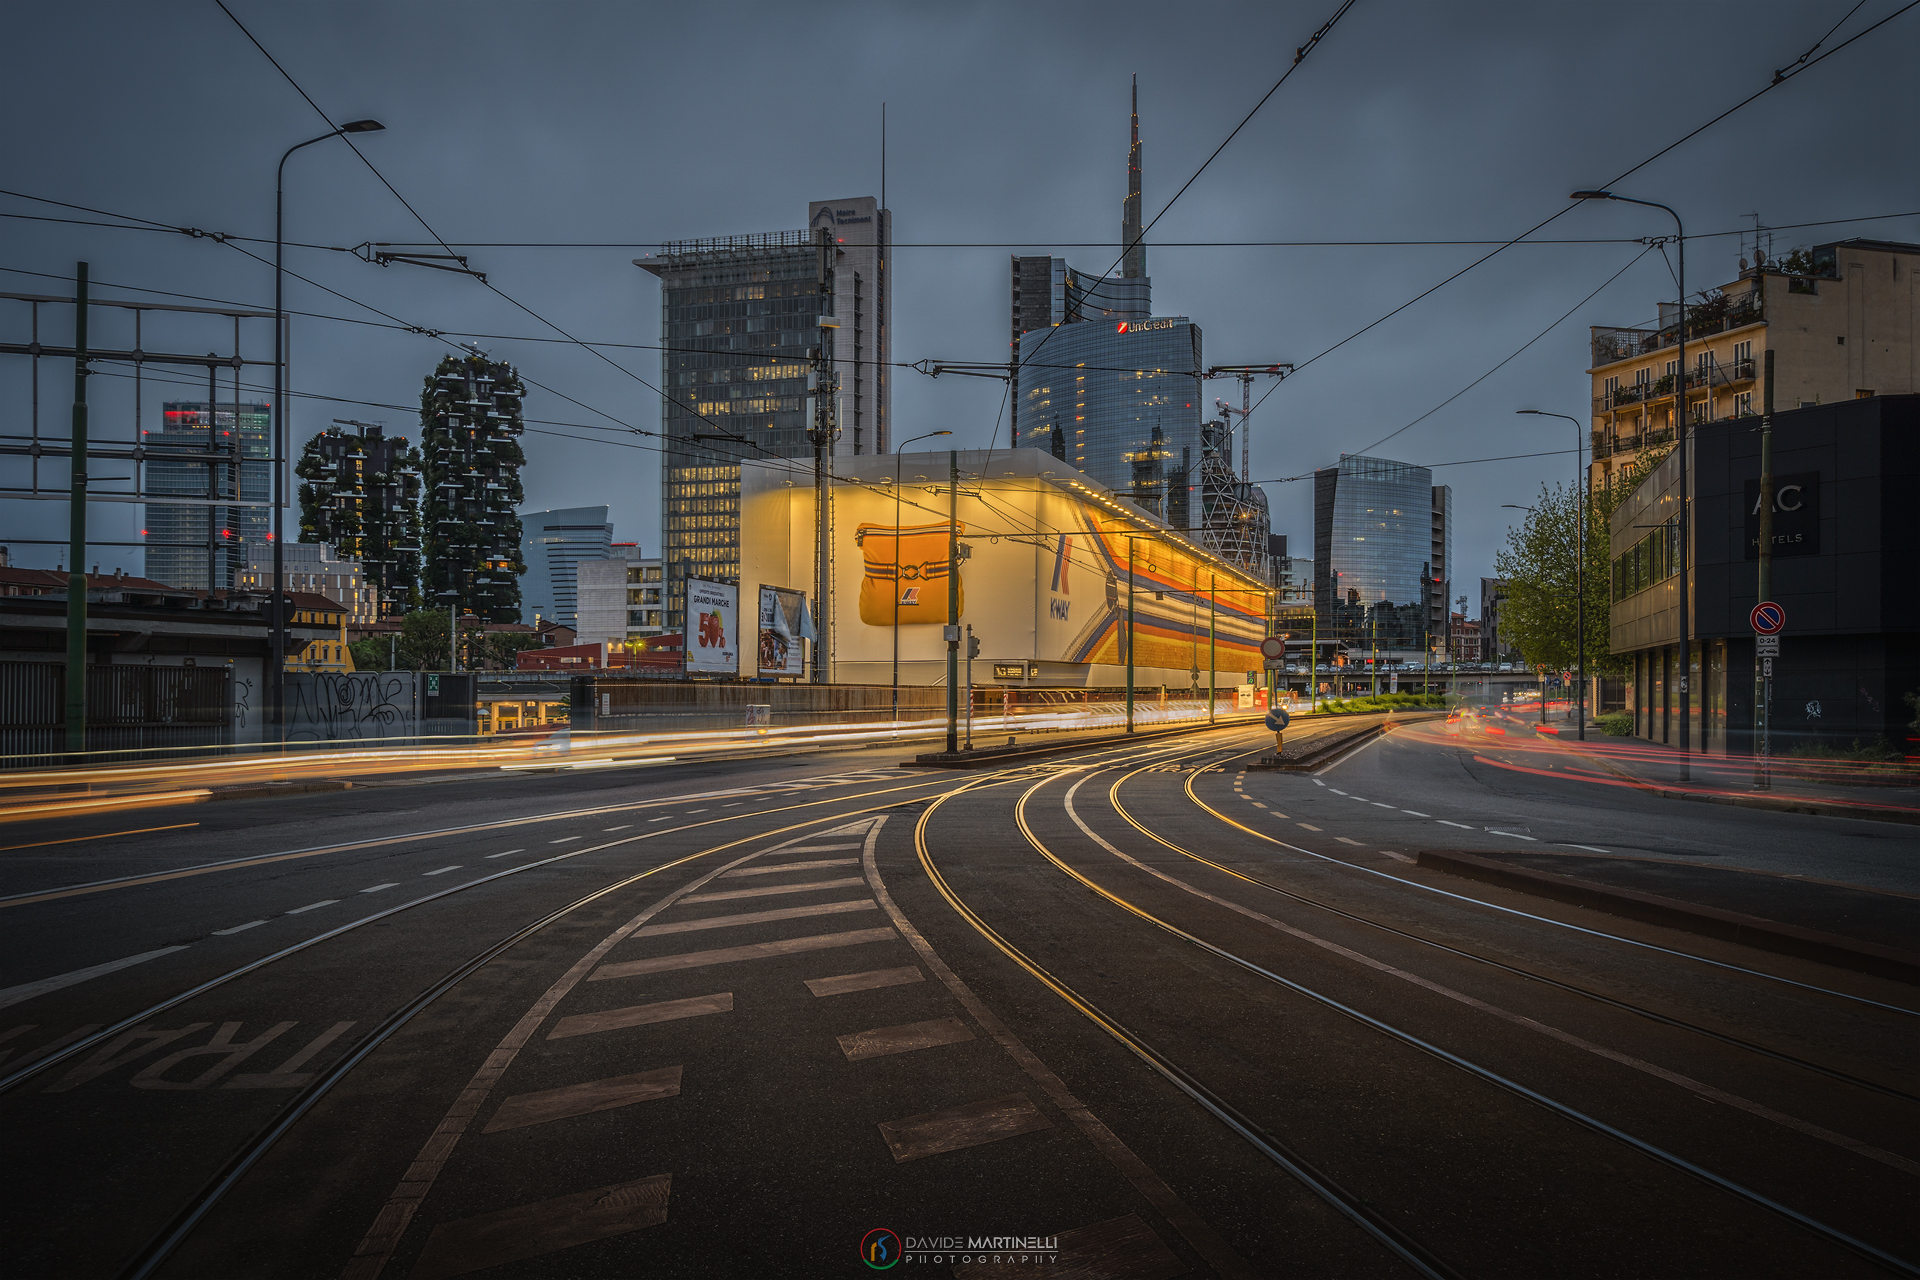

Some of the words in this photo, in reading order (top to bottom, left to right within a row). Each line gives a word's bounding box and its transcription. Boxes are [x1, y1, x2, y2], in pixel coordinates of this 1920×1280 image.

[837, 216, 871, 224] Tecnimont
[1129, 319, 1173, 332] UniCredit
[1752, 533, 1803, 546] HTELS
[693, 595, 711, 605] GRANDI
[711, 598, 730, 608] MARCHE
[1759, 637, 1776, 645] 0-24
